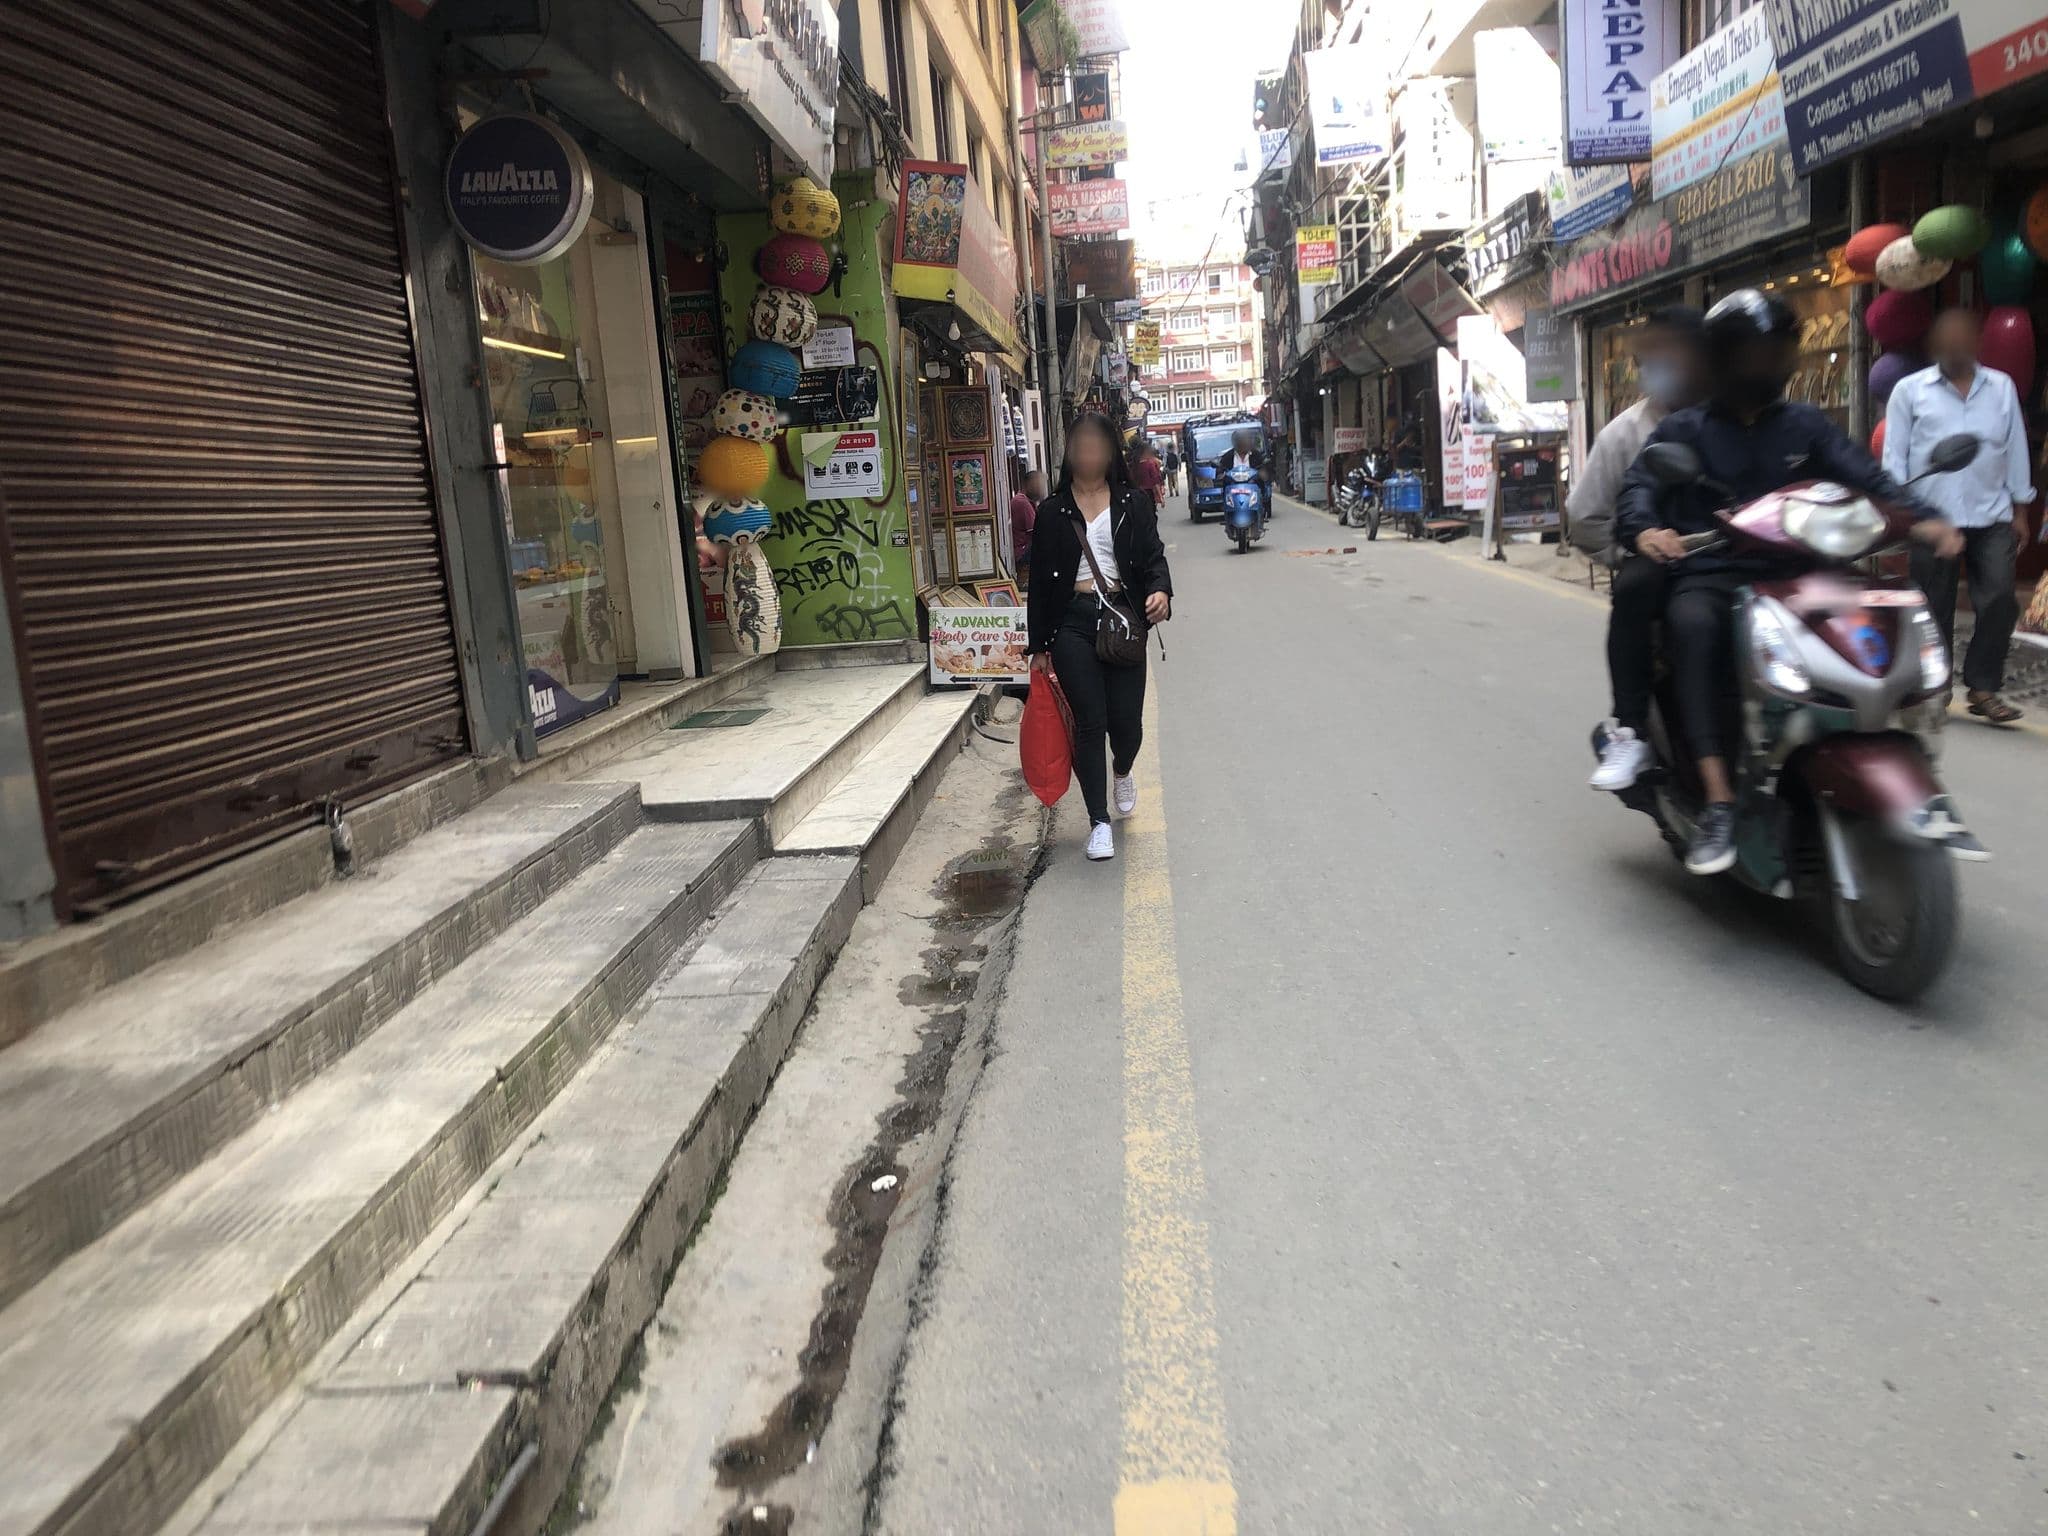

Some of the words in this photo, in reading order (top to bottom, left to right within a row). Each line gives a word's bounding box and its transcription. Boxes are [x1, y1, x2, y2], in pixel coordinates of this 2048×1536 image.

[1081, 34, 1112, 49] ANCE
[1823, 26, 1883, 72] Wholesales
[1883, 14, 1893, 43] &
[1668, 58, 1703, 104] Emerging
[1703, 34, 1728, 83] Nepal
[1729, 19, 1752, 63] Treks
[1754, 18, 1761, 46] &
[1806, 88, 1850, 128] Contact:
[1066, 124, 1111, 135] POPULAR
[461, 163, 558, 192] LAVAZZA
[1066, 183, 1106, 192] WELCOME
[488, 195, 529, 205] FAVOURITE
[530, 194, 560, 204] COFFEE
[1051, 193, 1069, 209] SPA
[1072, 193, 1079, 205] &
[1081, 188, 1126, 206] MASSAGE
[1302, 230, 1331, 240] TO-LET
[1136, 328, 1159, 338] CARGO
[1336, 430, 1366, 439] CARPET
[951, 616, 1010, 628] ADVANCE
[938, 631, 967, 644] Body
[971, 630, 999, 642] Care
[1003, 631, 1025, 644] Spa
